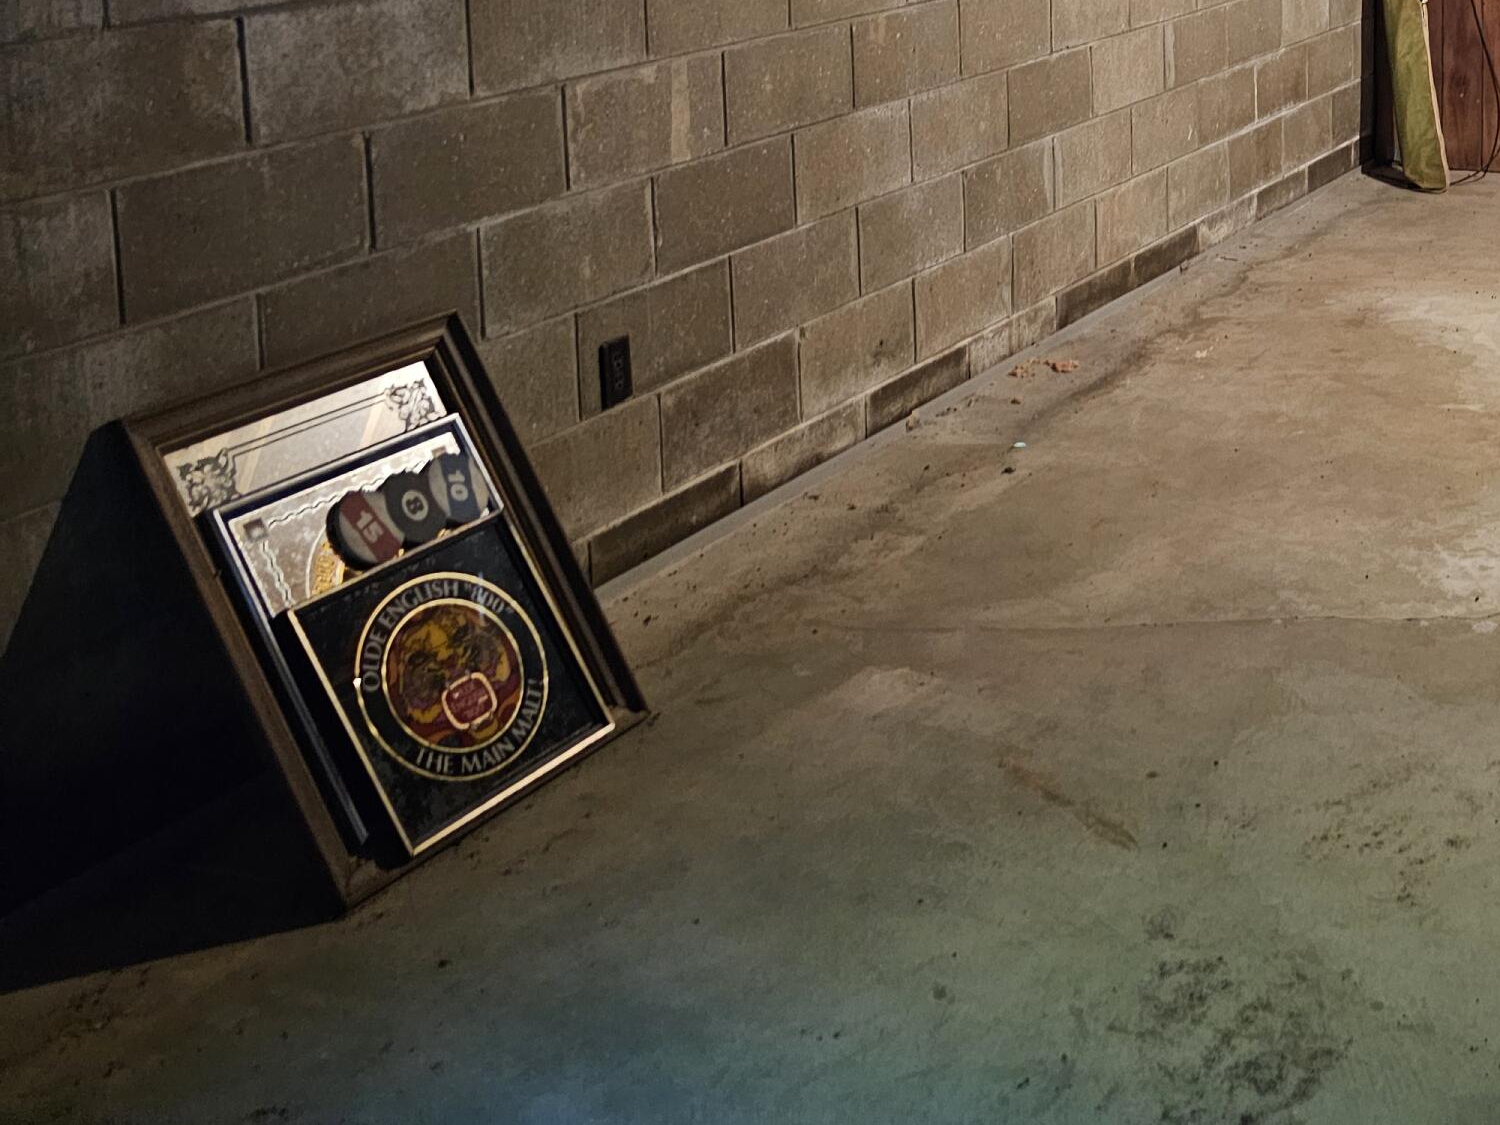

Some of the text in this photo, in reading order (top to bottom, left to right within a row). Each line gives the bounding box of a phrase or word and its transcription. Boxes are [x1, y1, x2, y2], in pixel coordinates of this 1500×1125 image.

[447, 469, 469, 502] 10
[405, 496, 424, 515] 8
[356, 509, 385, 544] 15
[361, 632, 387, 692] OLDE
[379, 580, 460, 629] ENGLISH
[416, 747, 455, 774] THE
[461, 738, 516, 774] MAIN
